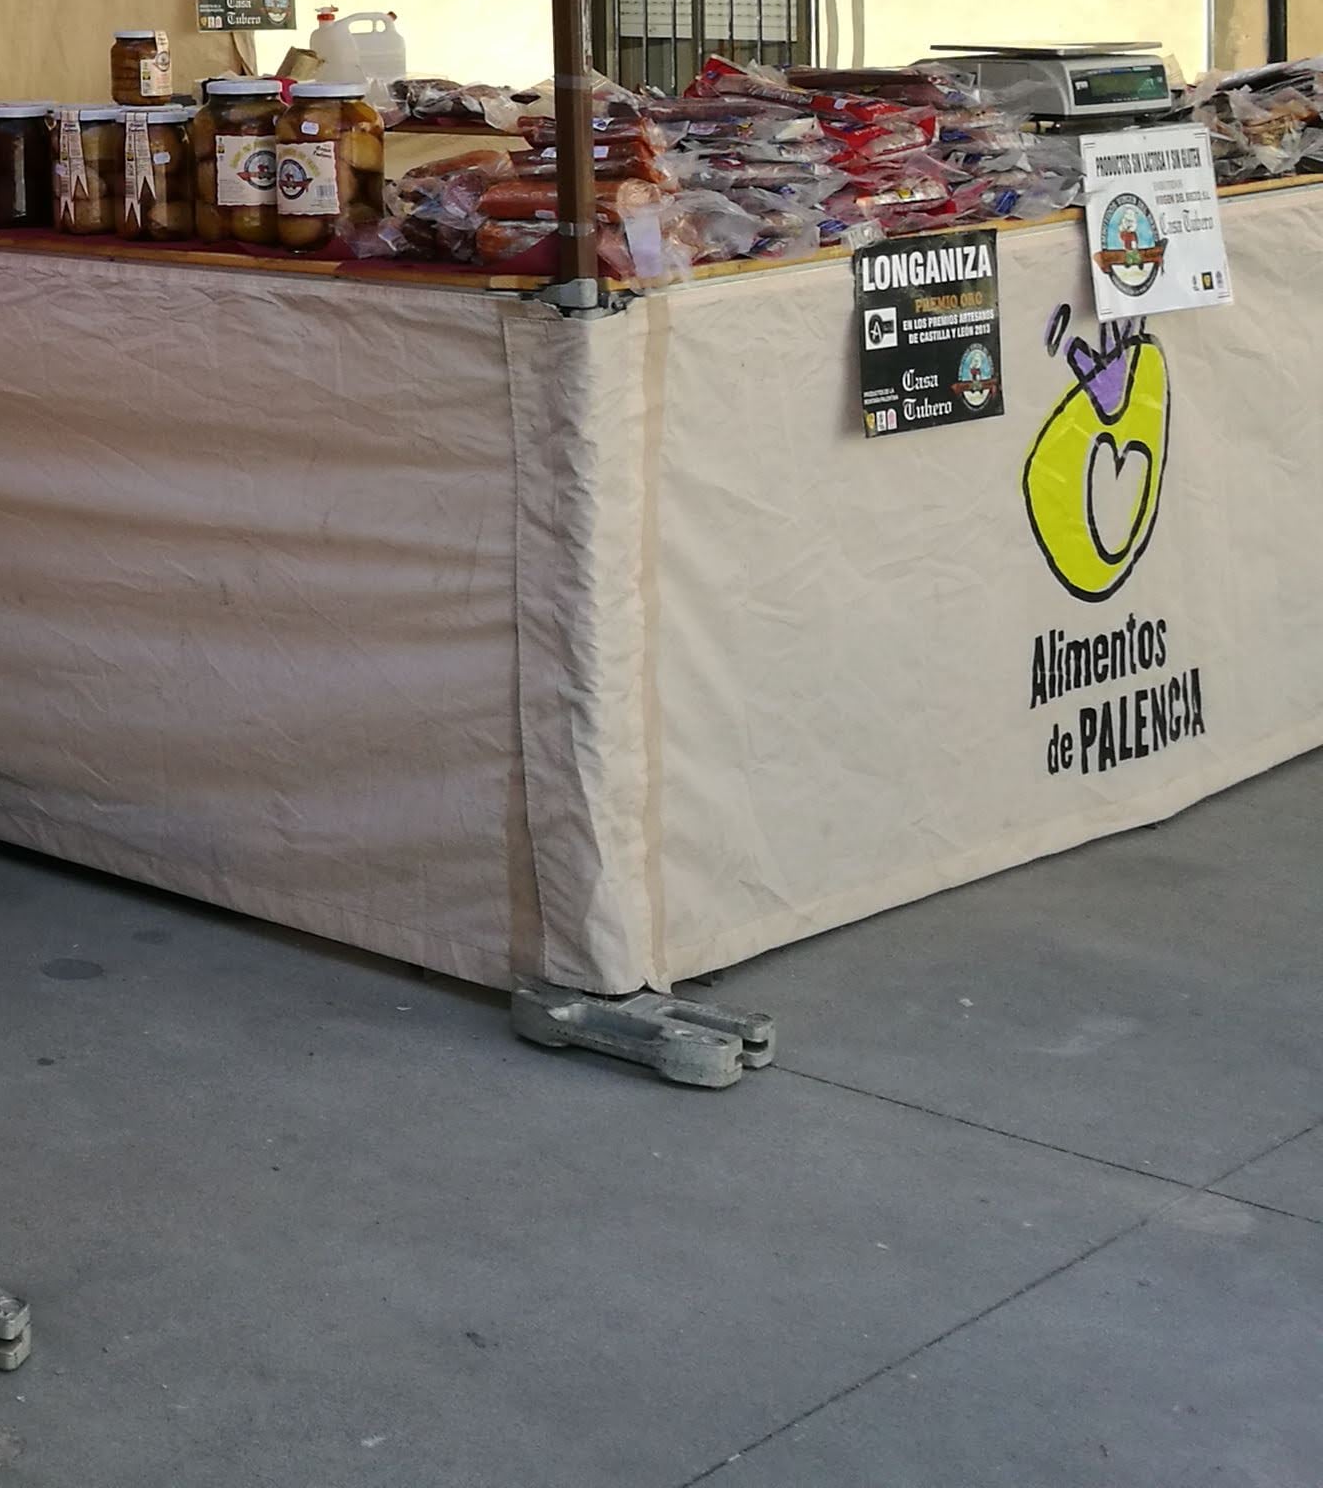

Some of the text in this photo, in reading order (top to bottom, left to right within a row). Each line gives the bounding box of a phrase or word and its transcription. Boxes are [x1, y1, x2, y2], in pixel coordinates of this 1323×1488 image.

[862, 244, 993, 292] LONGANIZA
[915, 291, 983, 314] PREMIO ORO
[902, 308, 995, 331] EN LOS PREMIOS ARTESANOS
[908, 333, 919, 345] DE
[919, 328, 951, 343] CASTILLA
[951, 327, 957, 339] Y
[902, 368, 939, 392] Casa
[903, 397, 953, 421] Tubero
[1029, 612, 1167, 710] Alimentos
[1047, 667, 1206, 775] de PALENCIA
